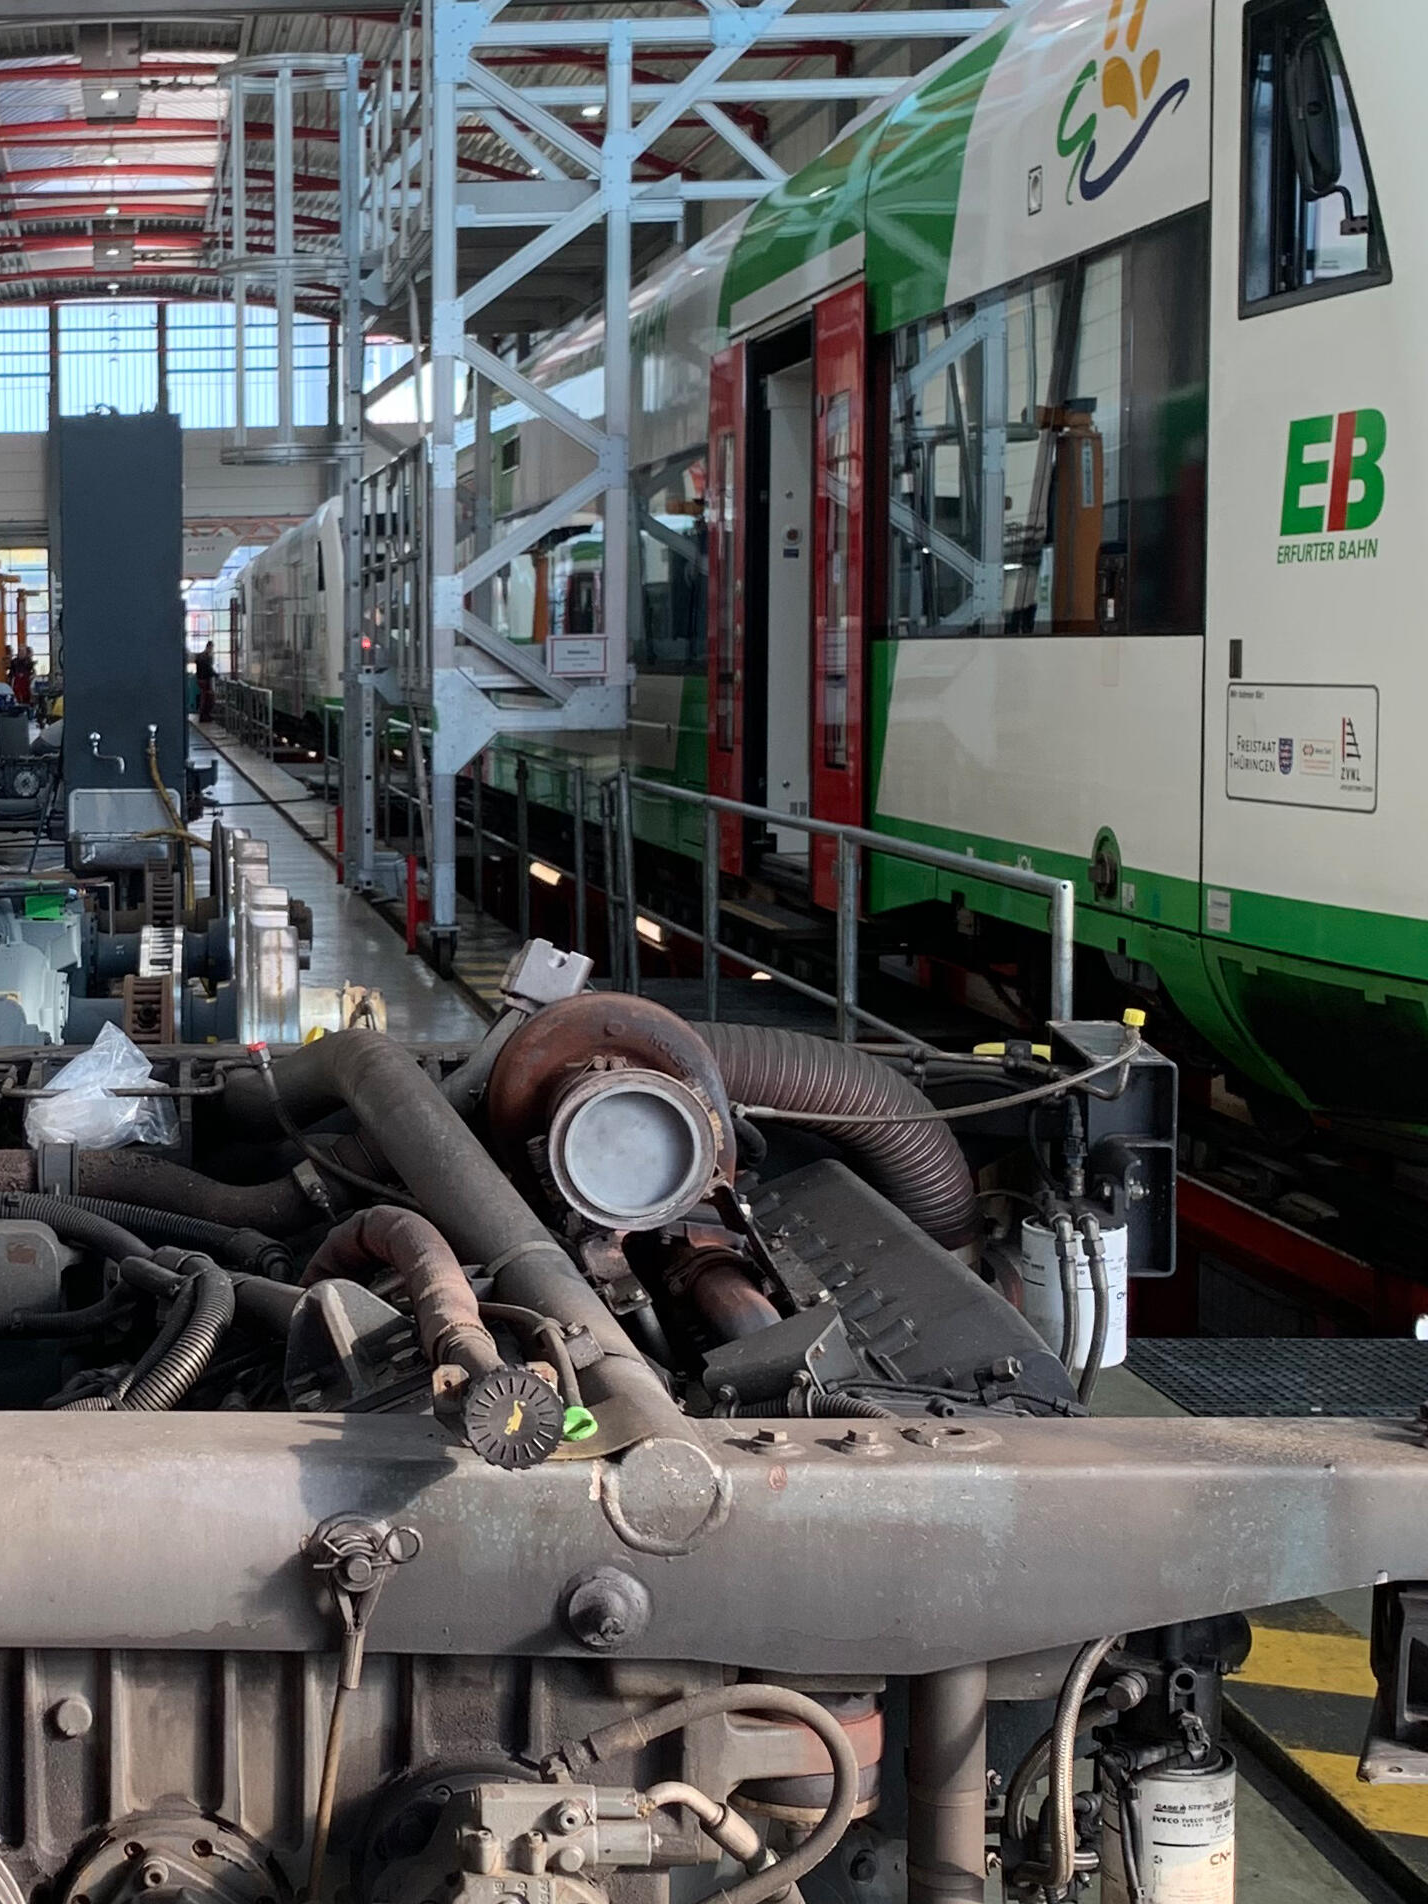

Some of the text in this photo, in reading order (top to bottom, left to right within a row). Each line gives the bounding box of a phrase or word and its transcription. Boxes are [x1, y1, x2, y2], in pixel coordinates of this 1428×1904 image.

[1276, 538, 1378, 565] ERFURTER BAHN
[1152, 1815, 1179, 1824] IVECO
